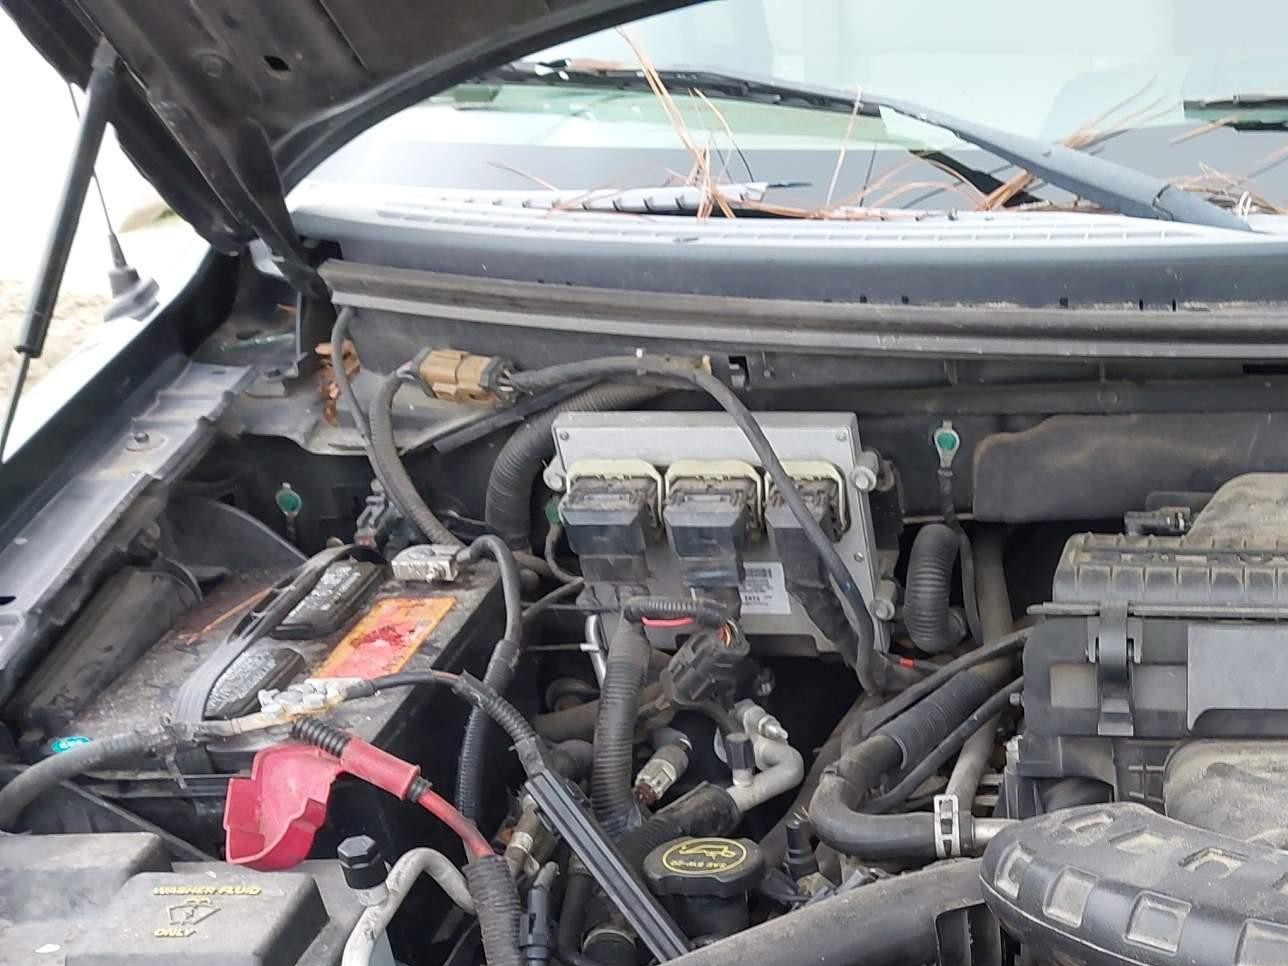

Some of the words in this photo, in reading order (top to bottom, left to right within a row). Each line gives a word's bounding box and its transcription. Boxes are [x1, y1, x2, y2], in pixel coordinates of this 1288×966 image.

[153, 886, 217, 896] WASHER
[218, 886, 262, 896] FLUID
[154, 927, 196, 938] ONLY
